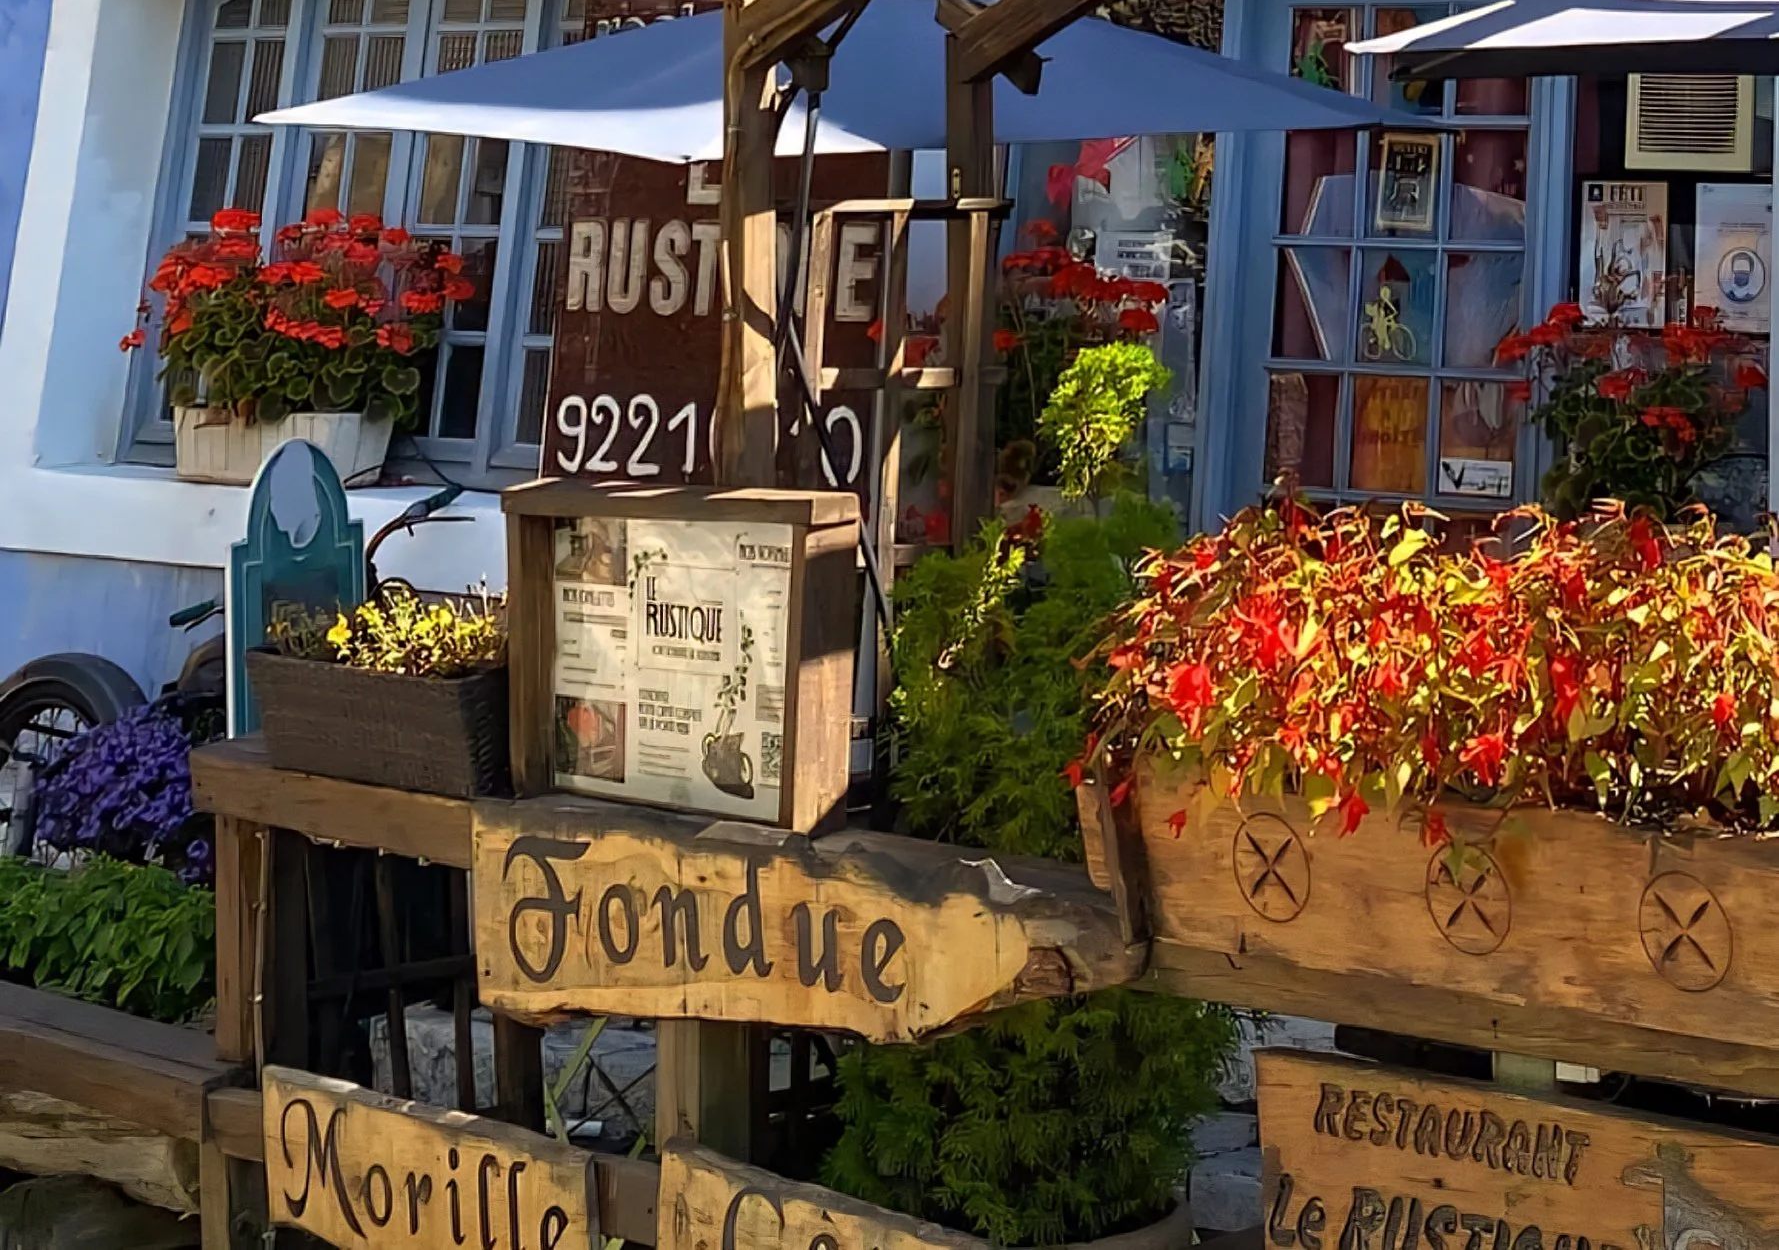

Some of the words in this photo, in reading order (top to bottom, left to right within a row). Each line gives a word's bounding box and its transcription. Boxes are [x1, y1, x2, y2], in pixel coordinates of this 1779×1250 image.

[646, 576, 656, 601] LE
[646, 602, 723, 645] RUSTIQUE
[502, 835, 907, 1004] Fondue
[1313, 1082, 1591, 1186] RESTAURANT
[1269, 1172, 1327, 1250] Le
